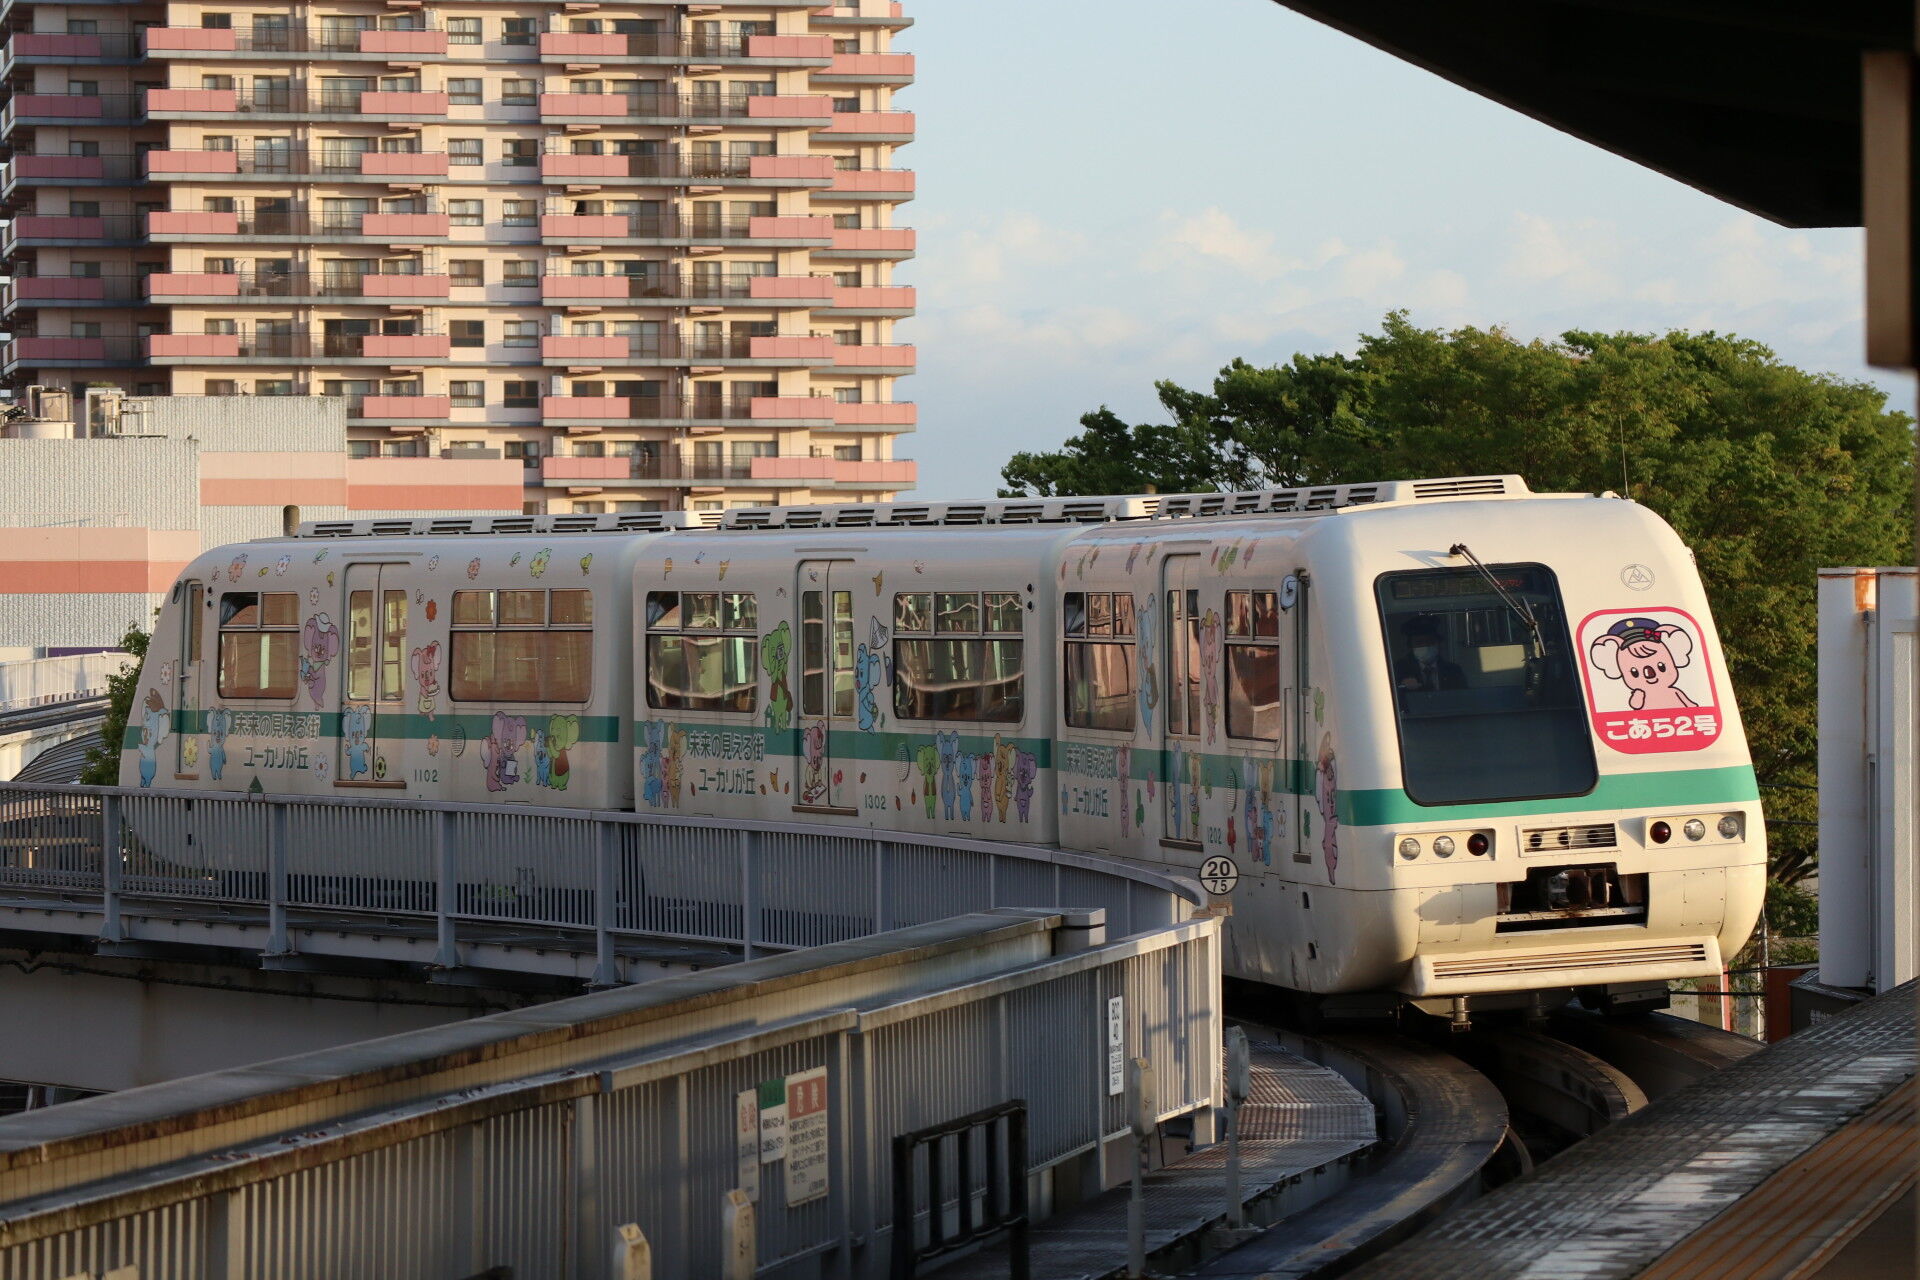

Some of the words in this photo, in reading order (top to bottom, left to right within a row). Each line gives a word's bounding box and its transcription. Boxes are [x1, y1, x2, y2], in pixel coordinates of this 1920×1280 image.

[235, 713, 320, 740] 未来の見える街
[1606, 714, 1717, 741] こあら2号
[690, 731, 765, 761] 未来の見える街
[243, 745, 309, 769] ユーカリが丘
[414, 769, 438, 783] 1102
[698, 768, 756, 794] ユーカリが丘
[864, 794, 886, 810] 1302
[1207, 826, 1223, 845] 1202
[1207, 860, 1231, 877] 20
[1211, 880, 1228, 893] 75
